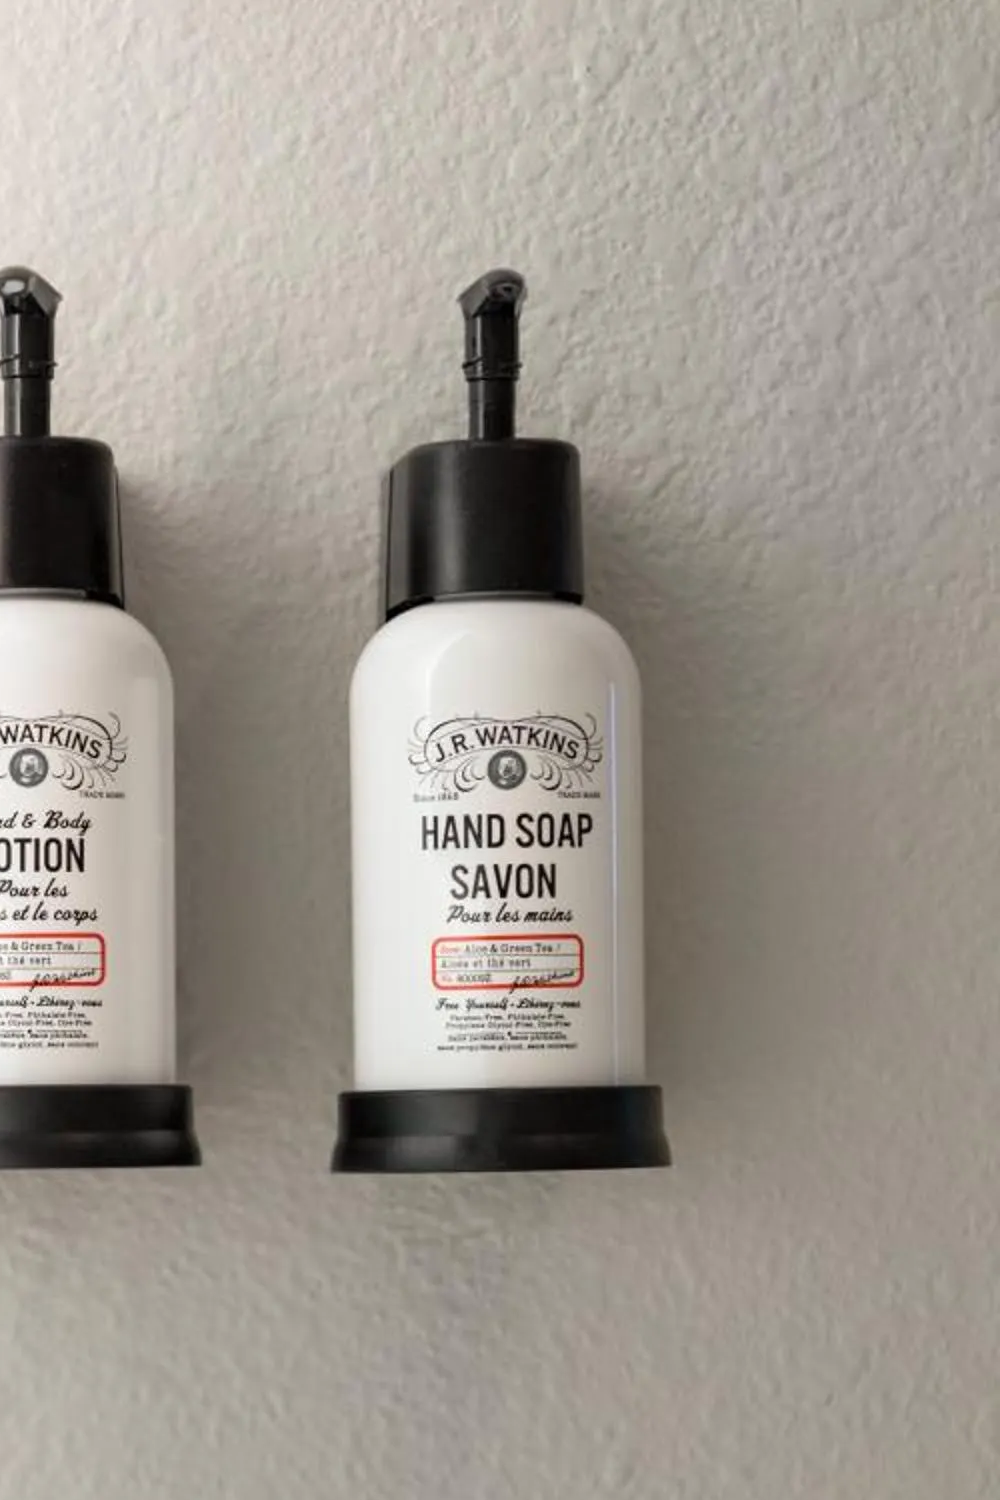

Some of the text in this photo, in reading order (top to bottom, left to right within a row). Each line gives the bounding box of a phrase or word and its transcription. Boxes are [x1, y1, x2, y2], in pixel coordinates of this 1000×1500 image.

[475, 724, 580, 760] WATKINS
[21, 812, 36, 828] &
[43, 809, 91, 836] Body
[421, 812, 594, 851] HAND SOAP
[43, 877, 69, 898] les
[449, 863, 557, 901] SAVON
[12, 904, 30, 922] et
[31, 900, 48, 922] le
[53, 907, 98, 926] corps
[446, 901, 574, 924] Pour les mains
